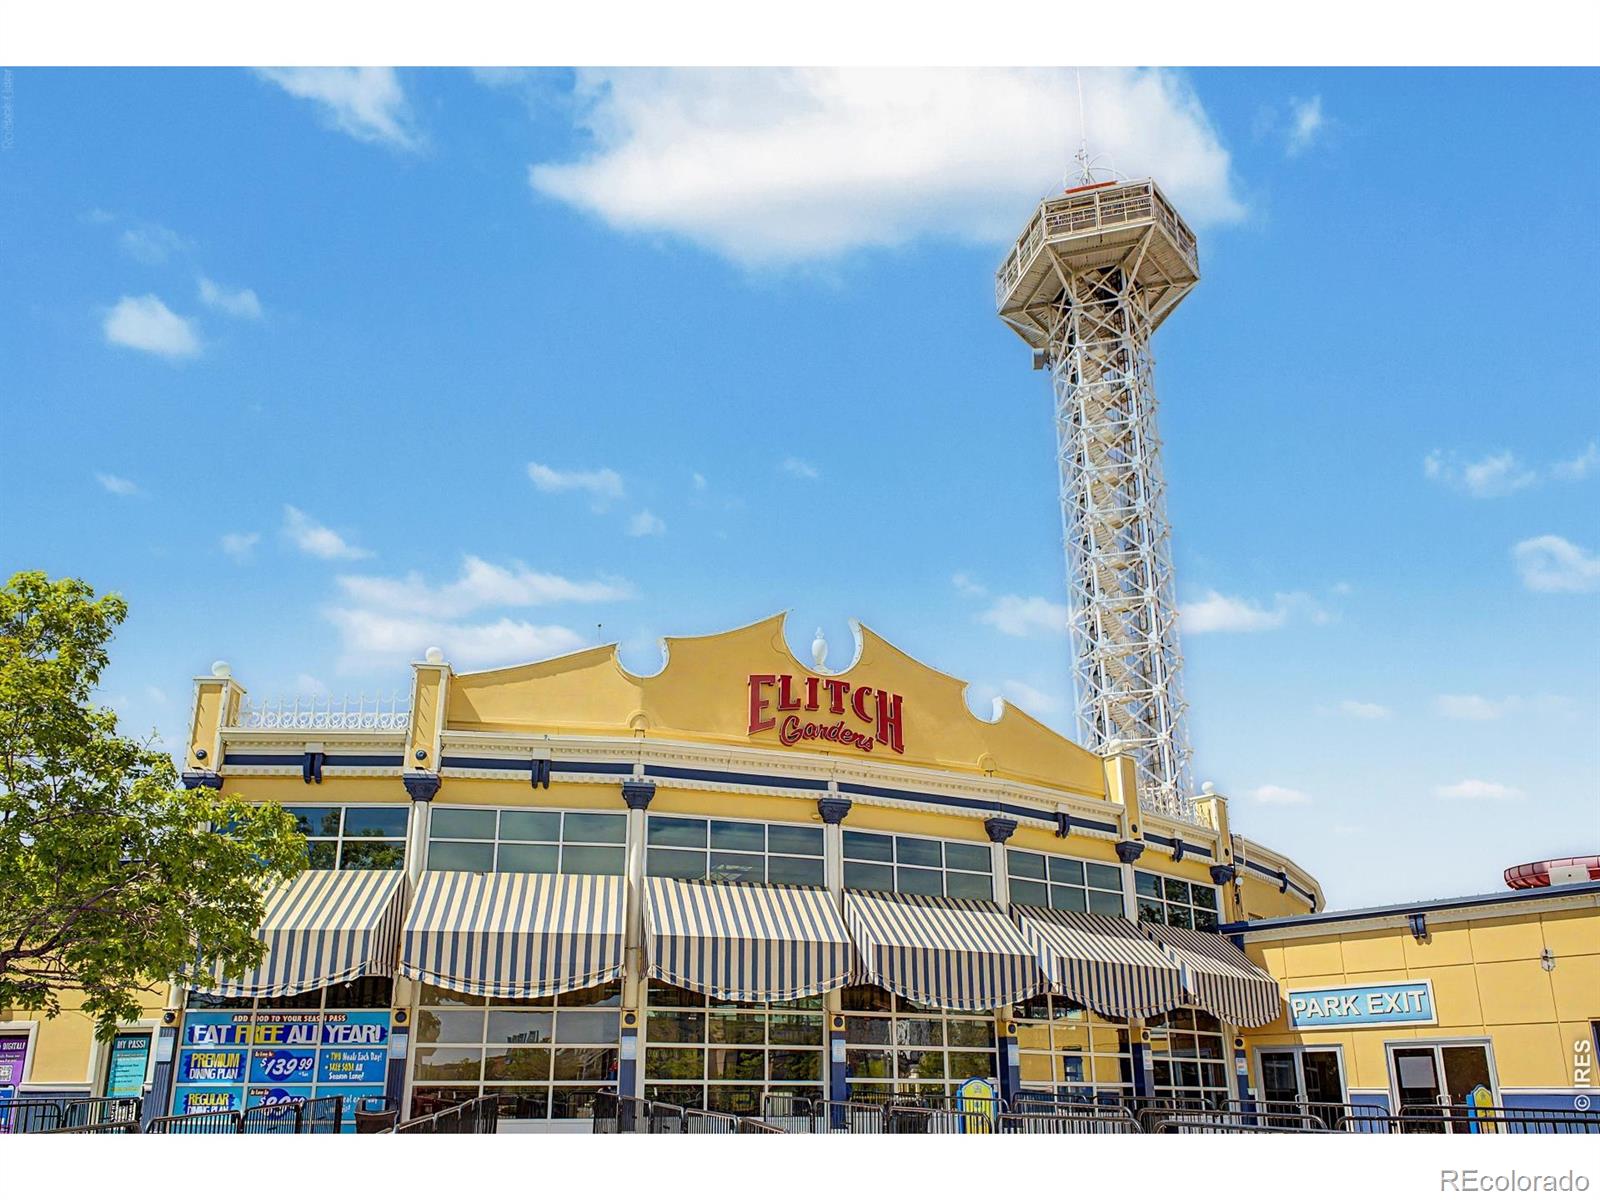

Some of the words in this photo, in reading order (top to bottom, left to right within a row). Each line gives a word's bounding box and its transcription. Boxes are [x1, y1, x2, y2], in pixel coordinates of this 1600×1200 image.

[748, 673, 904, 754] ELITCH
[779, 715, 874, 752] Gardens
[1292, 995, 1361, 1019] PARK
[1366, 990, 1426, 1015] EXIT
[303, 1014, 327, 1022] SEAS
[328, 1014, 346, 1022] PASS
[193, 1024, 231, 1044] EAT
[234, 1024, 285, 1044] FREE
[286, 1024, 319, 1044] ALL
[325, 1024, 381, 1043] YEAR!
[190, 1053, 241, 1068] PREMIUM
[357, 1052, 370, 1061] Each
[189, 1068, 216, 1080] DINING
[217, 1068, 239, 1080] PLAN
[328, 1072, 348, 1080] Season
[348, 1072, 365, 1081] Long!
[188, 1093, 229, 1106] REGULAR
